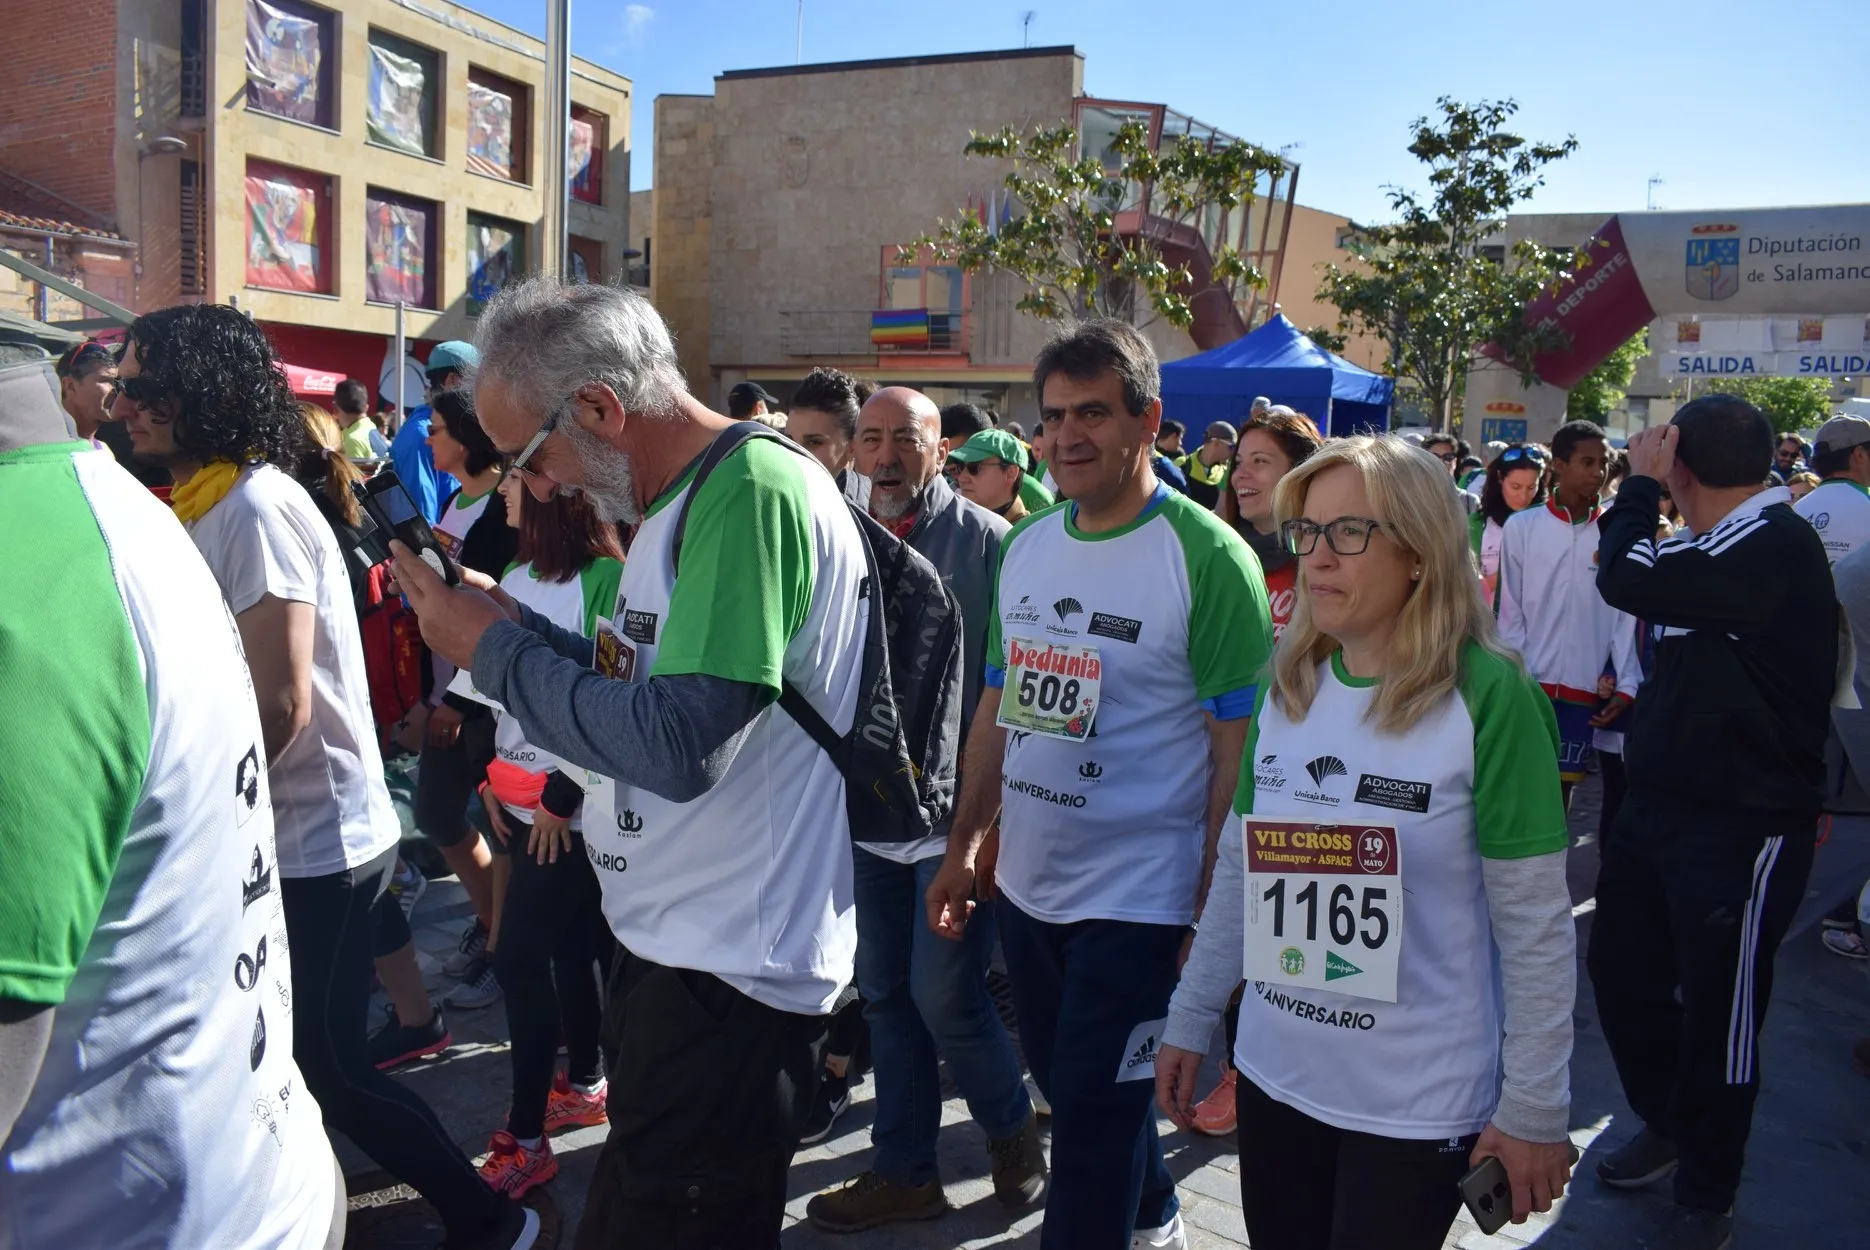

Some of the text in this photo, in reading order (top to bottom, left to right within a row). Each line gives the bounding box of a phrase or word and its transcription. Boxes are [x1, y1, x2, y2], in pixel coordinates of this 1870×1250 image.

[1748, 233, 1861, 258] Diputación
[1556, 252, 1627, 316] DEPORTE
[1747, 268, 1766, 282] de
[1679, 356, 1755, 373] SALIDA
[1094, 614, 1139, 630] ADVOCATI
[1009, 640, 1100, 681] bedunia
[1018, 670, 1080, 715] 508
[1008, 778, 1087, 808] ANIVERSARIO
[1363, 776, 1427, 795] ADVOCATI
[1372, 787, 1414, 799] ABOGADOS
[1294, 790, 1341, 804] Unicaja Banco
[1254, 830, 1353, 852] VII CROSS
[1364, 837, 1384, 854] 19
[1256, 850, 1312, 865] Villamayor
[1317, 854, 1353, 867] ASPACE
[1363, 859, 1383, 867] MAYO
[1263, 878, 1389, 950] 1165
[1263, 988, 1376, 1031] ANIVERSARIO
[1127, 1053, 1158, 1068] adidas
